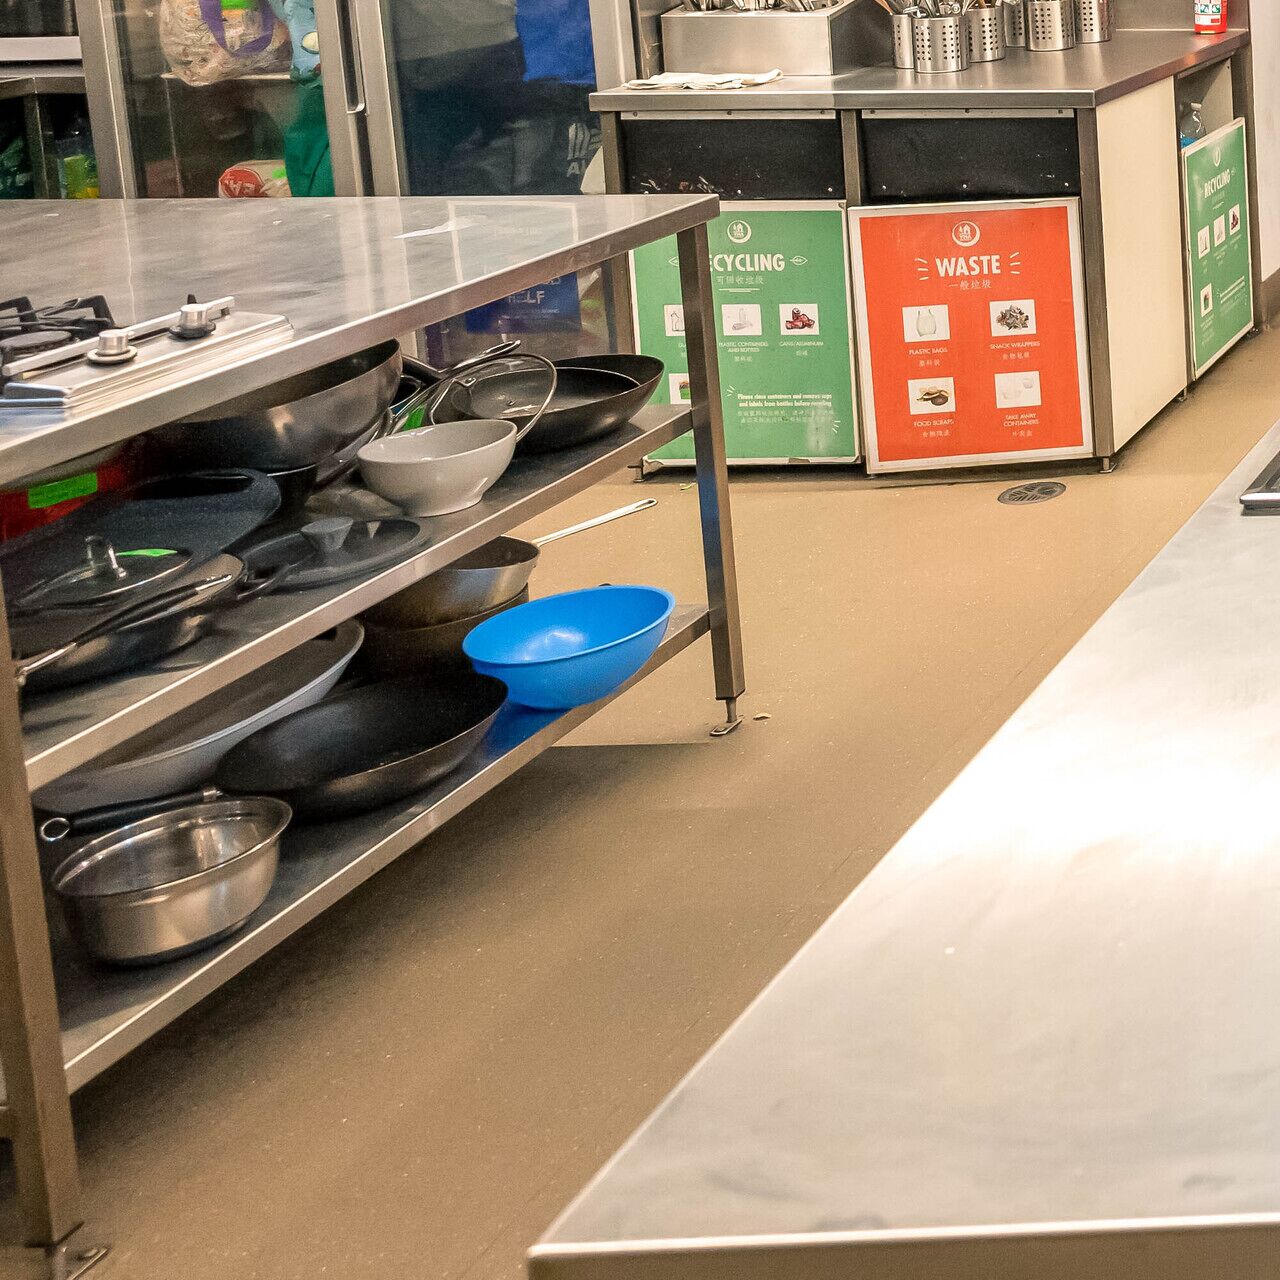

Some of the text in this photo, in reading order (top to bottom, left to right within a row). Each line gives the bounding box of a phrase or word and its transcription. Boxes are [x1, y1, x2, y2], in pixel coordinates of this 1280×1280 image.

[1204, 169, 1231, 199] RECYCLING
[709, 254, 785, 271] CYCLING
[935, 255, 1001, 277] WASTE
[908, 348, 931, 356] PLASTIC
[1004, 419, 1040, 427] CONTAINERS
